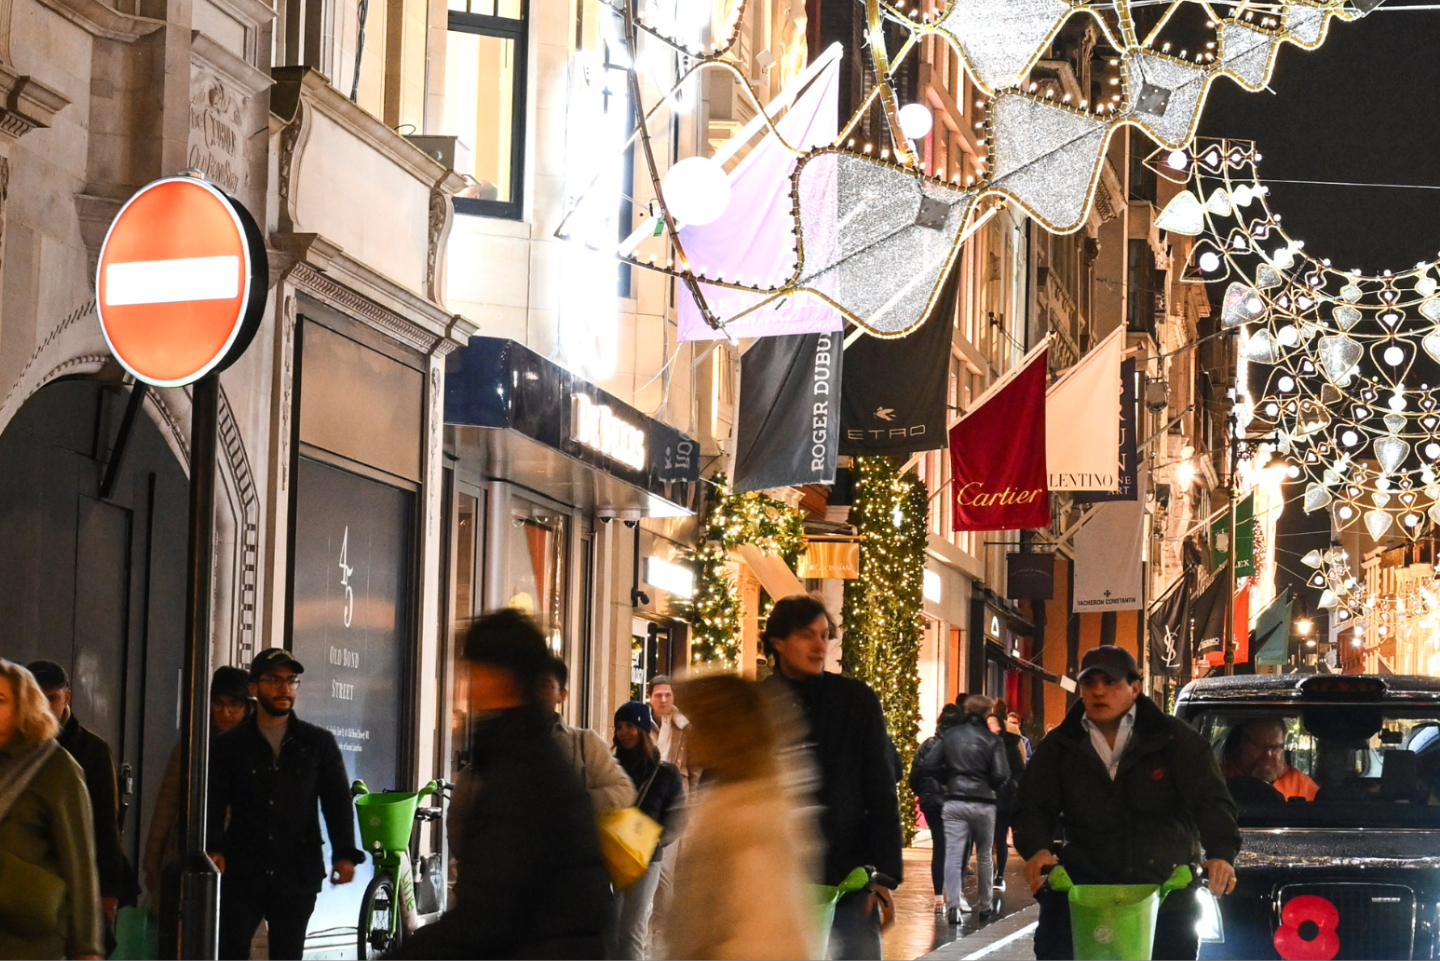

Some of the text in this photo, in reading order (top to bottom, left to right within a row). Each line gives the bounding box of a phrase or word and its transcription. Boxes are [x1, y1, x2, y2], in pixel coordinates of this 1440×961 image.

[811, 401, 828, 472] ROGER
[1048, 472, 1114, 488] LENTINO
[957, 481, 1043, 507] Cartier
[329, 645, 360, 669] OLD BOND
[331, 679, 355, 701] STREET
